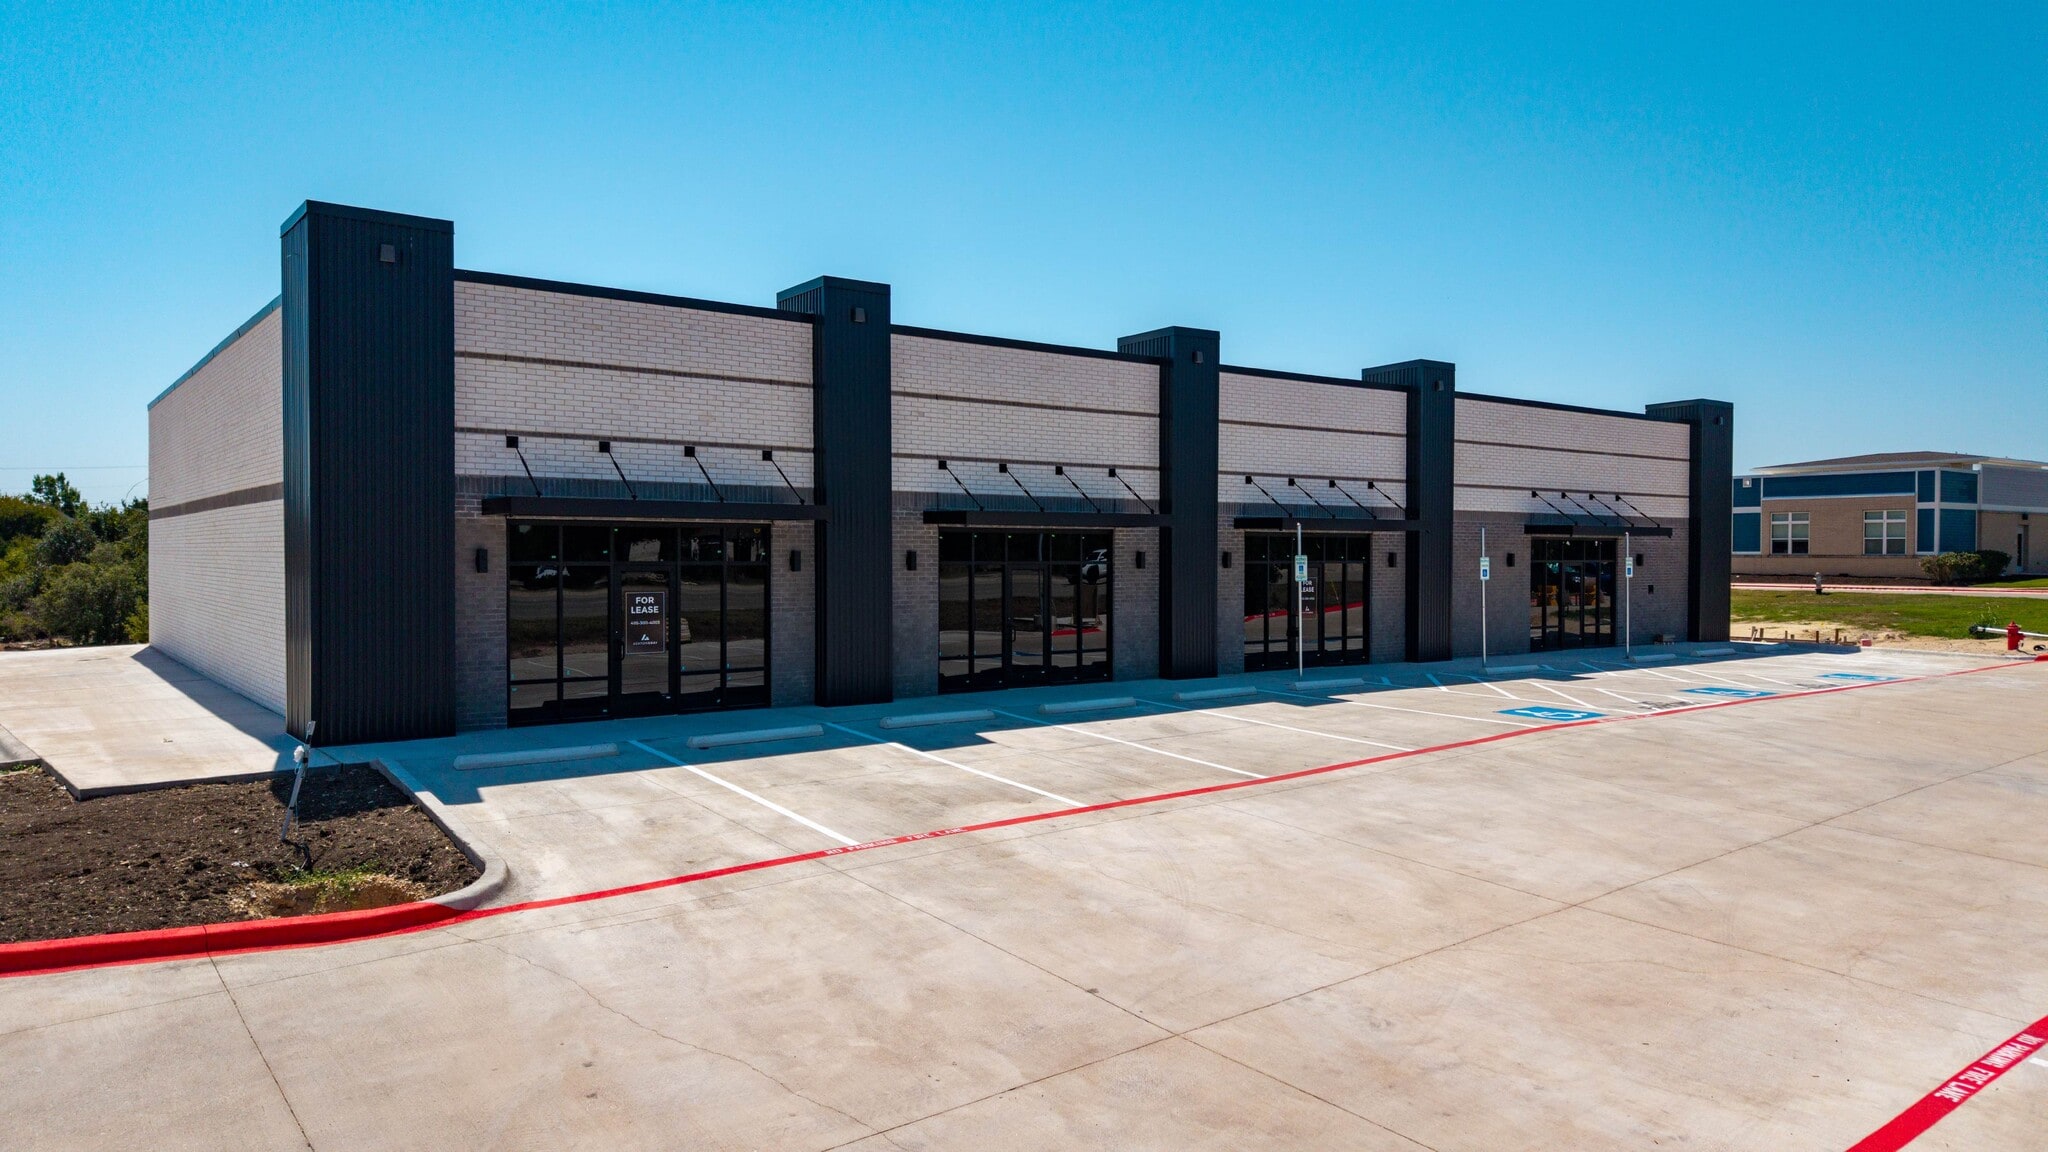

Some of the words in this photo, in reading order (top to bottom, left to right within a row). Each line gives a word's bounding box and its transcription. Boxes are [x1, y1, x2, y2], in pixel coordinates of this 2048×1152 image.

[635, 596, 654, 604] FOR
[630, 606, 659, 614] LEASE
[2015, 1033, 2044, 1045] NO
[1980, 1041, 2033, 1068] PARKING
[1959, 1067, 1995, 1085] FIRE
[1934, 1081, 1976, 1102] LANE
